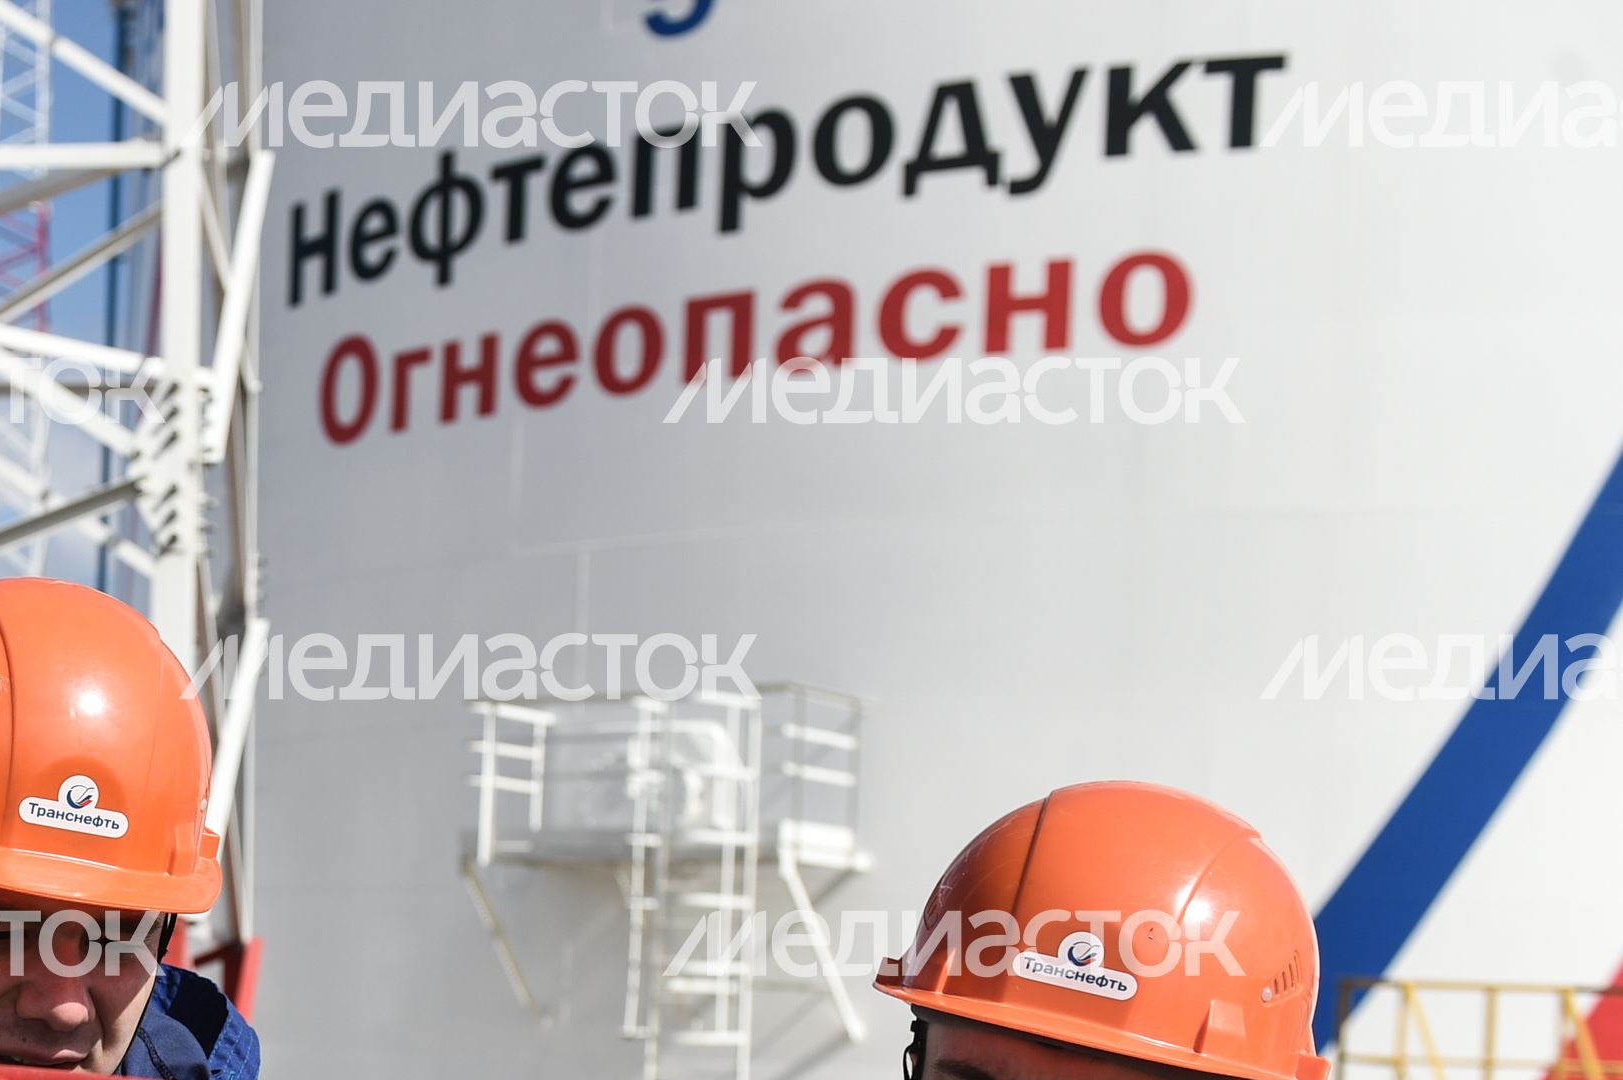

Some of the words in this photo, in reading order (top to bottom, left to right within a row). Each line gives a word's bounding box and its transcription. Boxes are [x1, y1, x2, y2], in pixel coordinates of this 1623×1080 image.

[285, 52, 1290, 308] Нефтепродукт
[317, 246, 1195, 448] Огнеопасно
[28, 801, 121, 832] Транснефть
[1023, 955, 1129, 993] Транснефть
